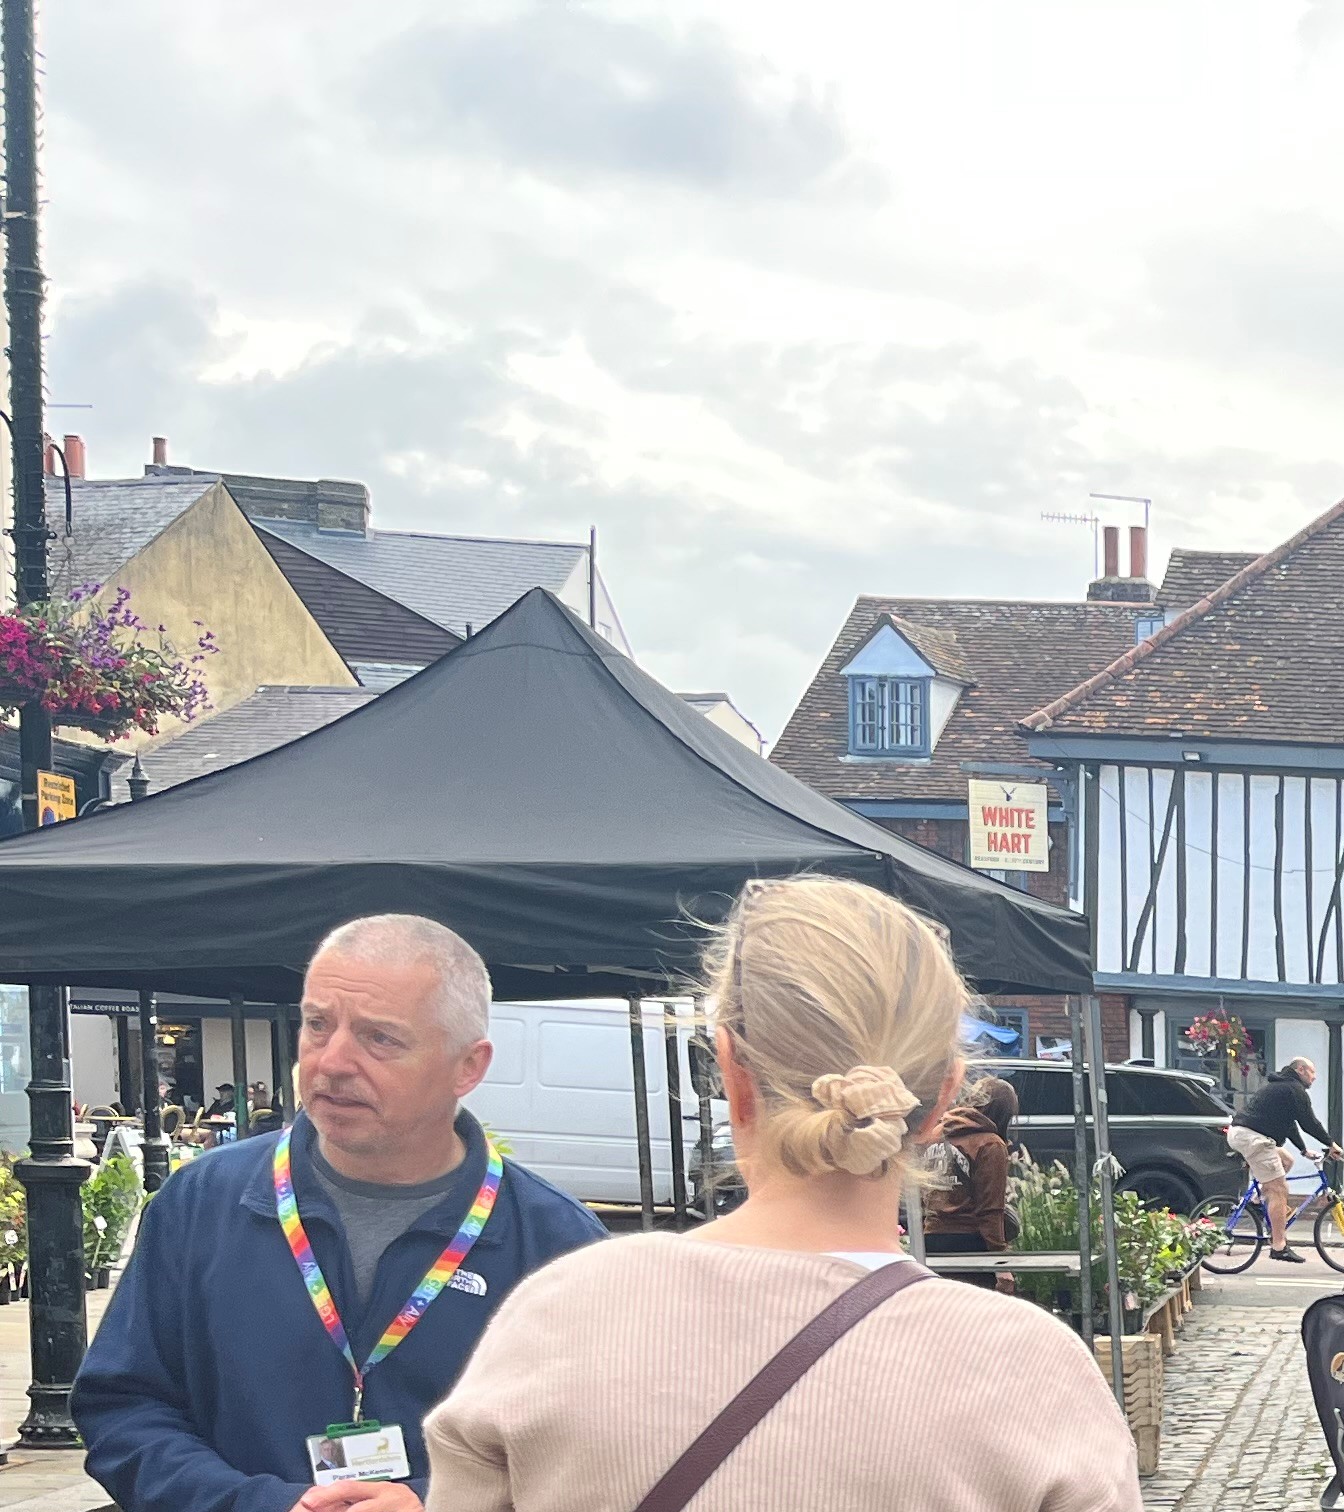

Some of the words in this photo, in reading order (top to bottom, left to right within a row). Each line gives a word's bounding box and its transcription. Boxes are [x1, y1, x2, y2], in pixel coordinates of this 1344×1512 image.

[982, 805, 1036, 829] WHITE
[987, 831, 1032, 854] HART
[70, 1003, 93, 1011] TALIAN
[95, 1004, 120, 1012] COFFEE
[121, 1005, 140, 1013] ROAS
